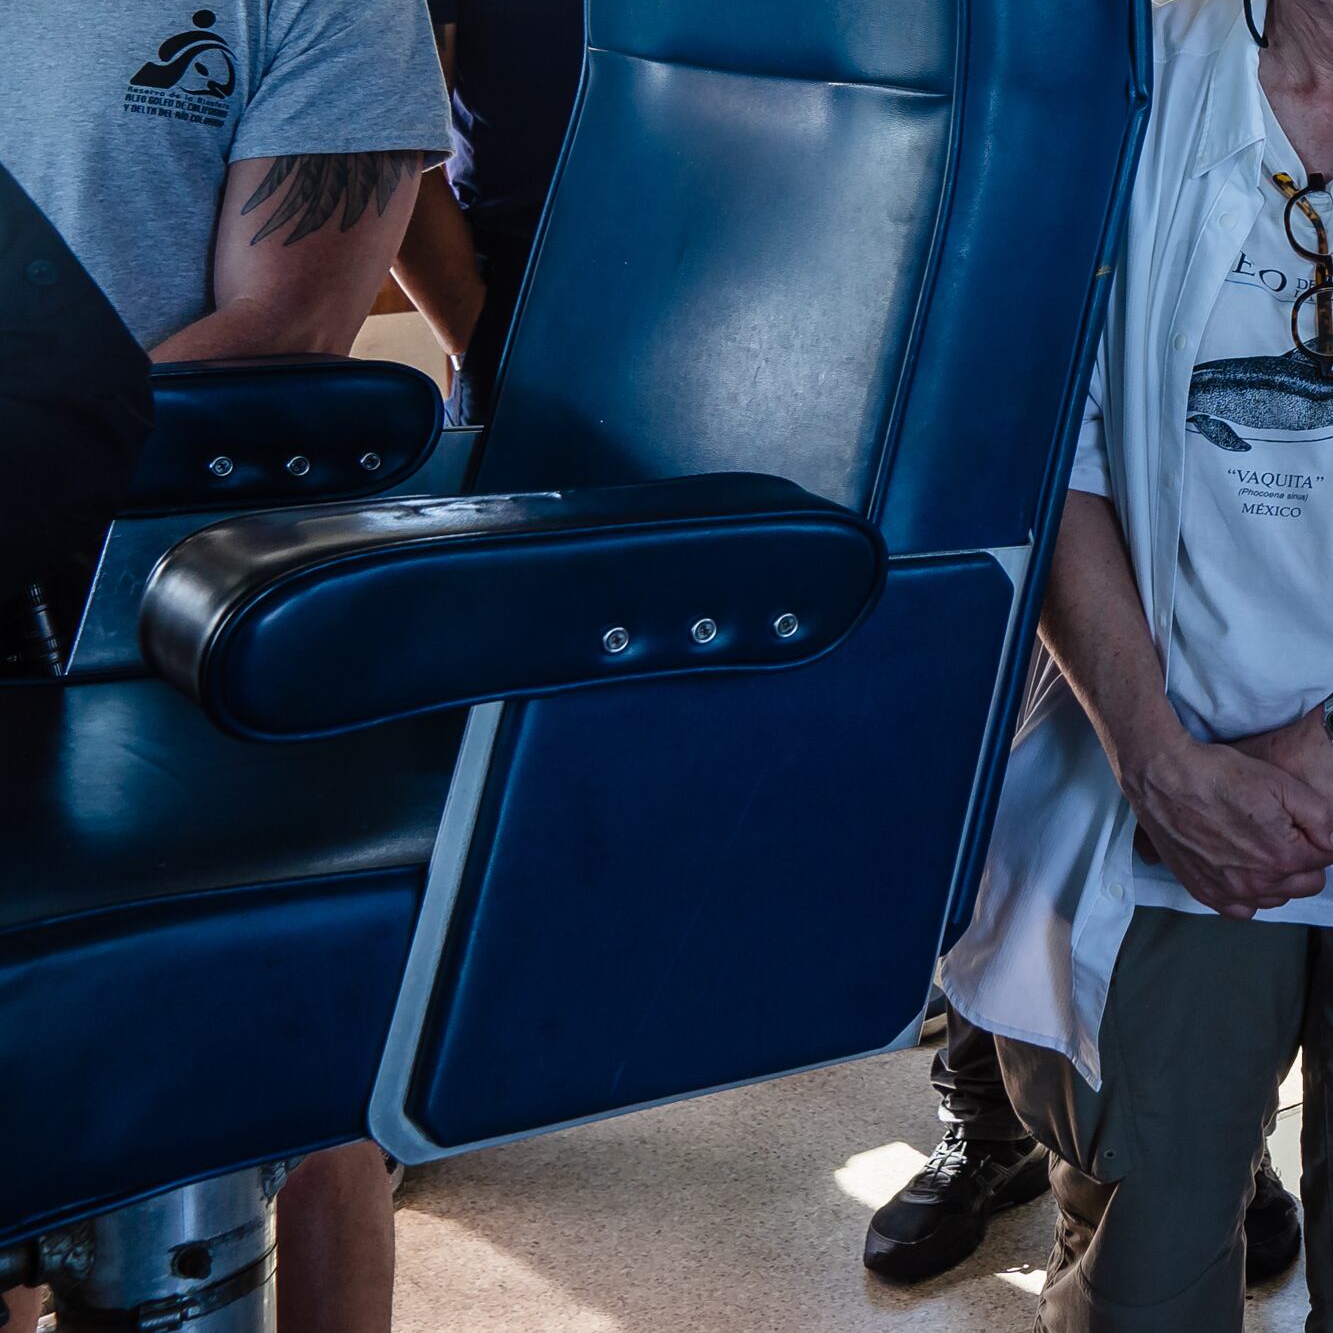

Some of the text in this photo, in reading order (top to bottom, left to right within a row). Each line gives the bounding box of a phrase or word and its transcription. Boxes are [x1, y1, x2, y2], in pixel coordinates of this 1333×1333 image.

[125, 93, 147, 104] ALTO
[148, 95, 174, 108] GOLFO
[175, 99, 187, 110] DE
[169, 92, 180, 100] de
[123, 103, 130, 112] Y
[131, 104, 157, 116] DELTA
[158, 107, 172, 118] DEL
[1238, 487, 1309, 503] (Phocoena sinus)
[1241, 502, 1302, 519] MÉXICO
